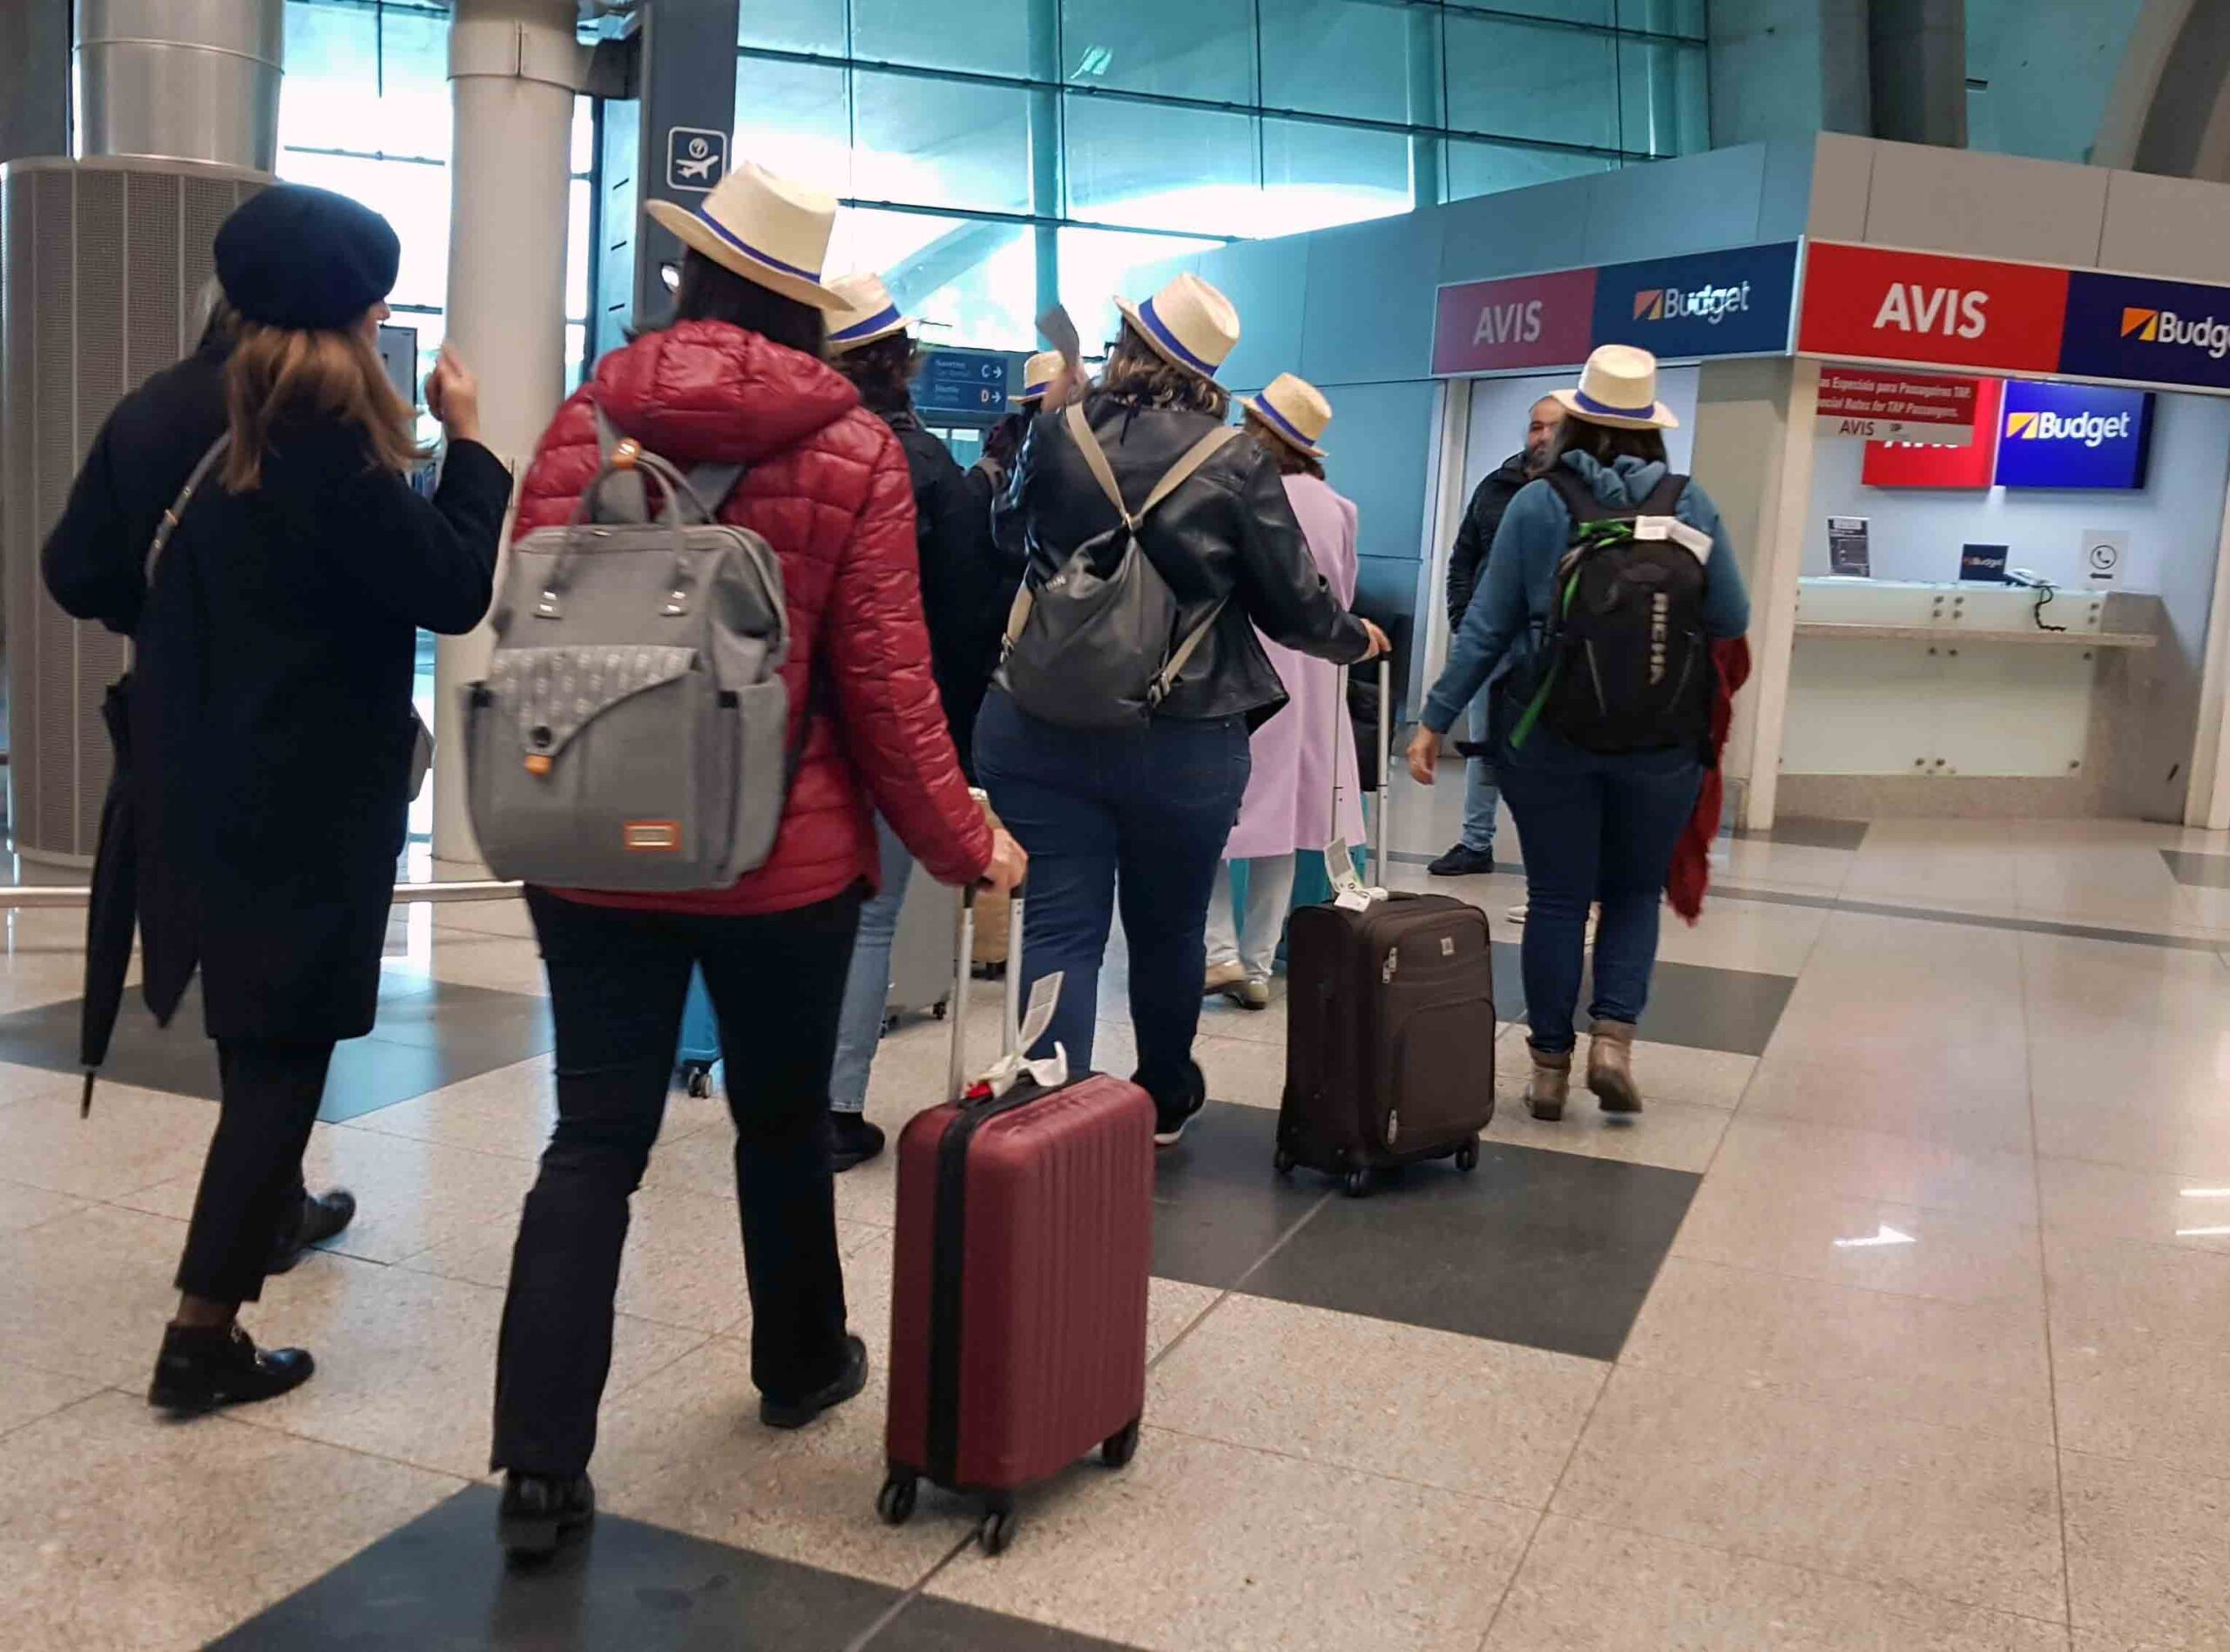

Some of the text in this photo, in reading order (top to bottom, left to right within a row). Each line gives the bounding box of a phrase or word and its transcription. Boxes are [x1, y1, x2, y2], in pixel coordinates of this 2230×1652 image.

[1473, 280, 1751, 346] AVIS Budget
[1873, 282, 1989, 339] AVIS
[981, 364, 990, 379] C
[981, 389, 990, 403] D
[1845, 397, 1872, 411] Rates
[1871, 400, 1888, 413] for
[1887, 401, 1906, 414] TAP
[1840, 419, 1875, 436] AVIS
[2038, 411, 2131, 448] Budget
